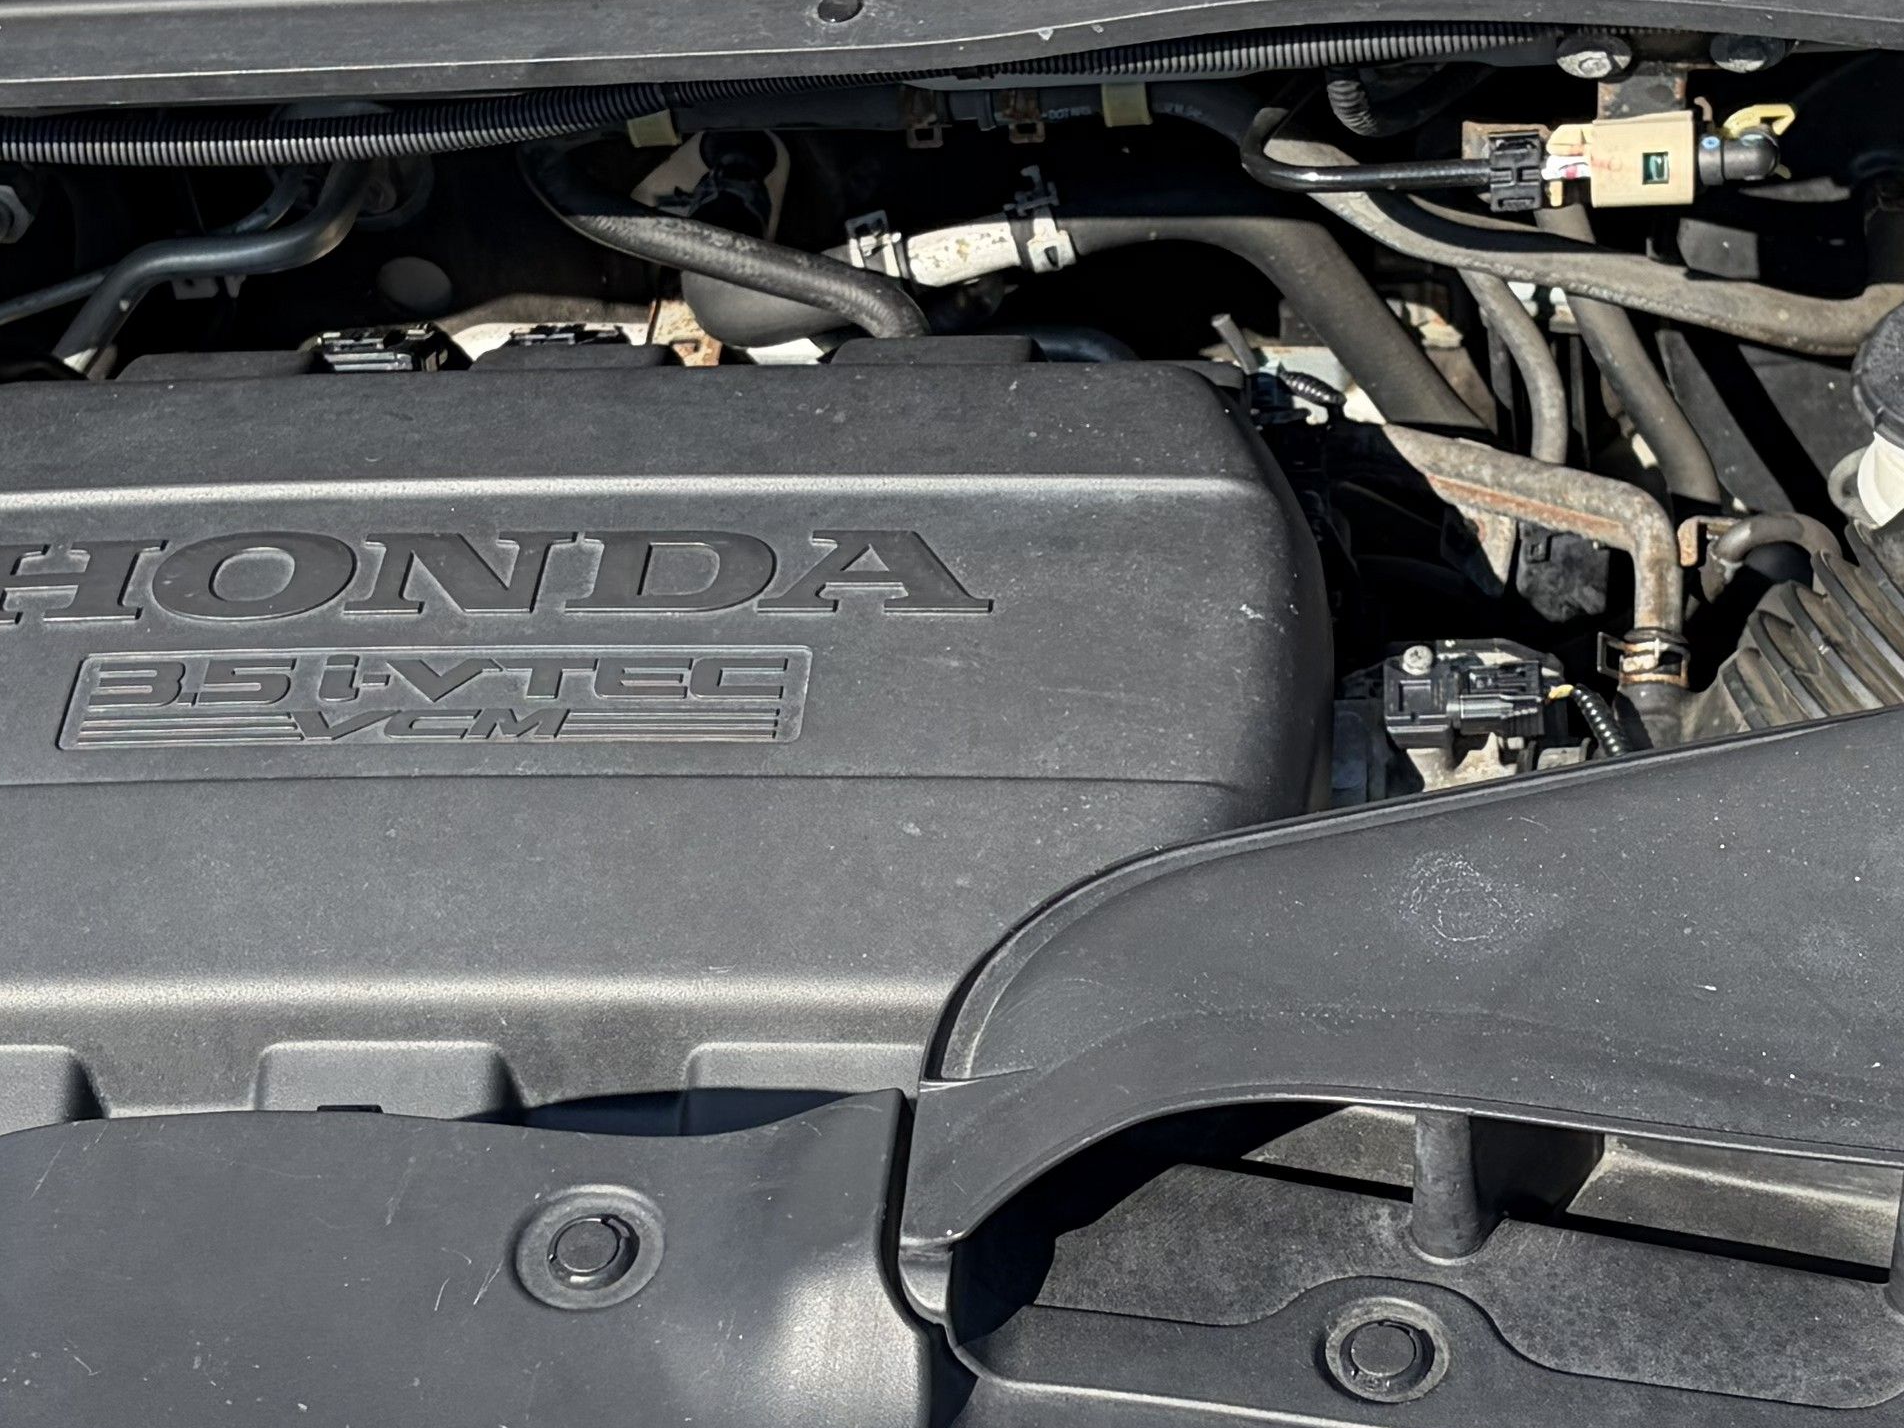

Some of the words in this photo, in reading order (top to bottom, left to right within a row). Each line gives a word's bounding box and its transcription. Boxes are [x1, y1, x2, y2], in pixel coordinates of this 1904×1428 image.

[86, 654, 296, 709] 3.5
[316, 653, 791, 705] i-VTEC
[302, 705, 572, 744] VCM
